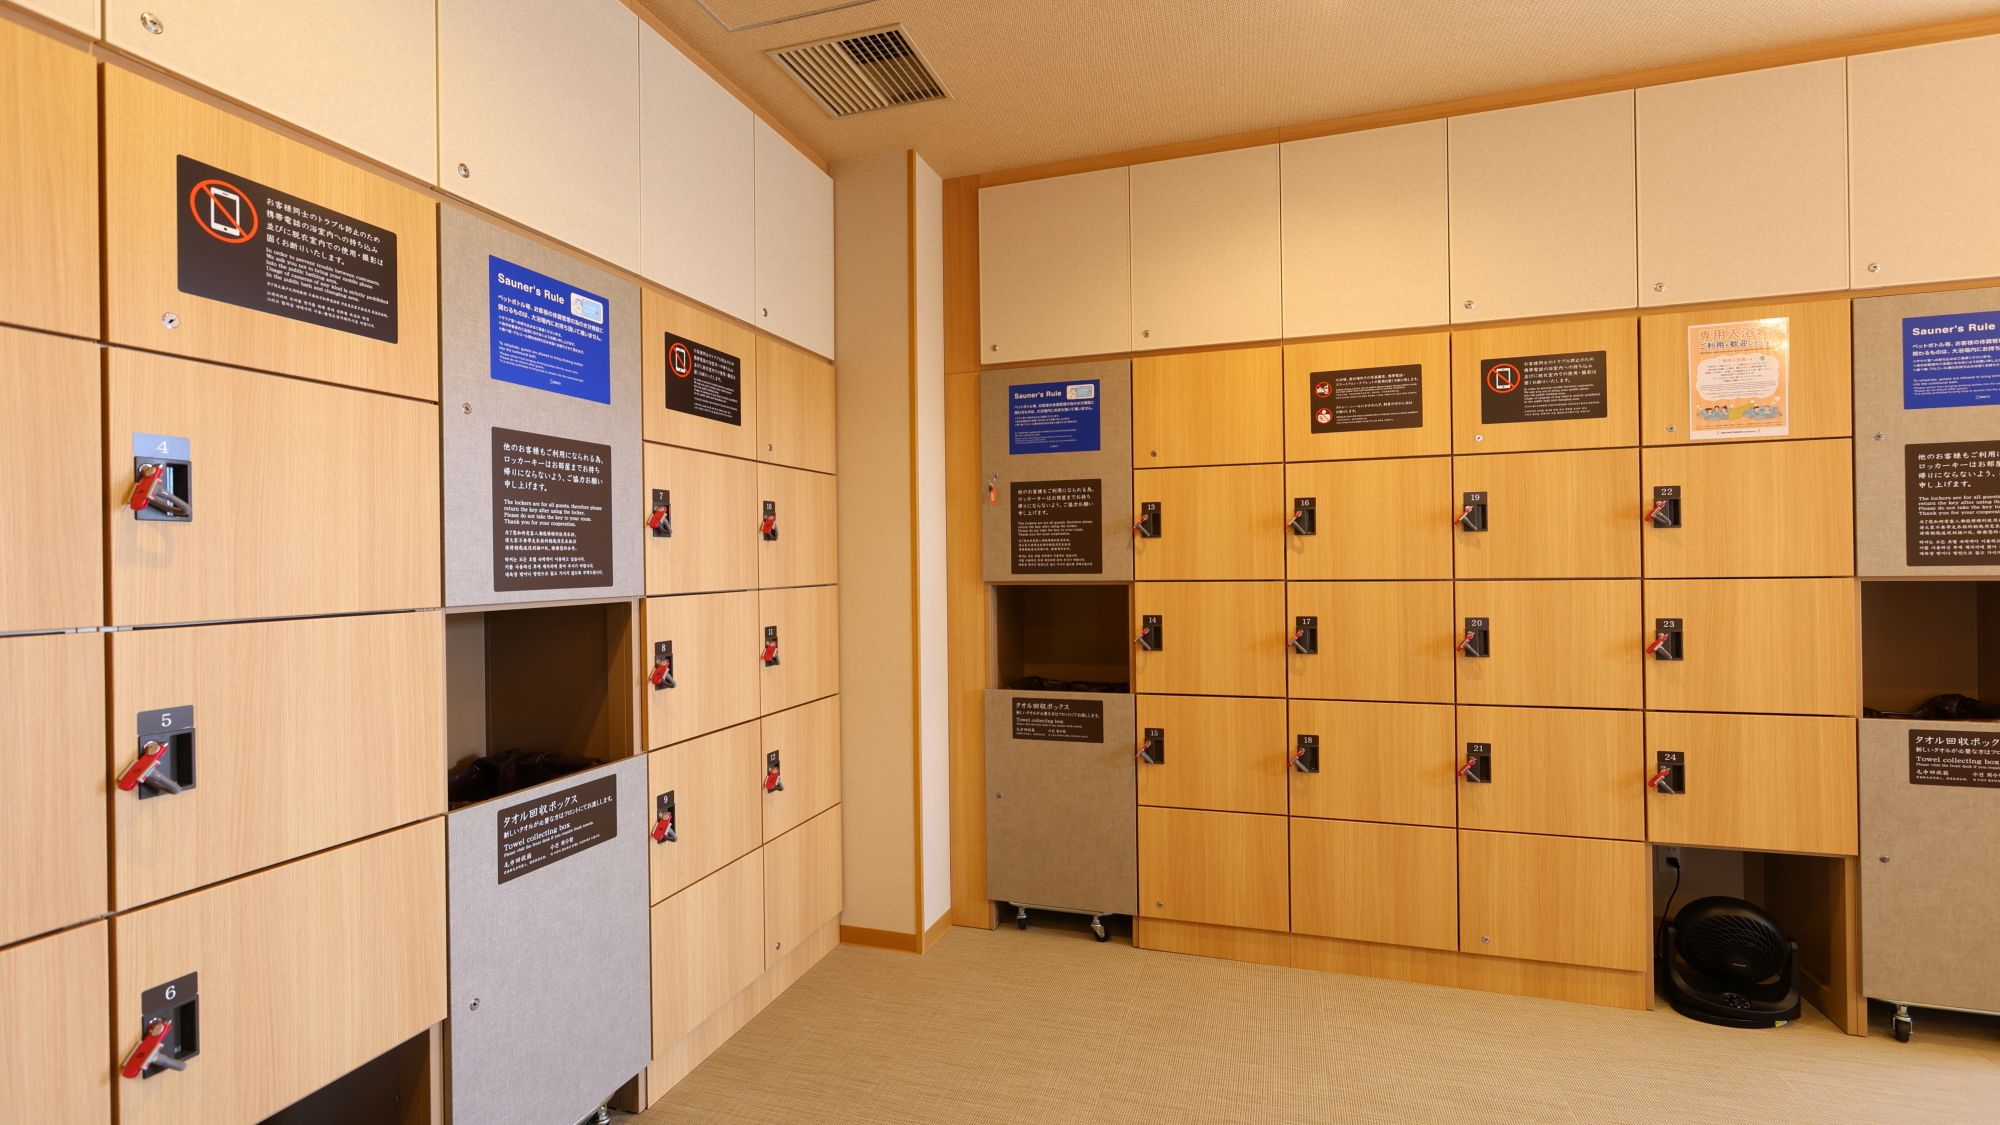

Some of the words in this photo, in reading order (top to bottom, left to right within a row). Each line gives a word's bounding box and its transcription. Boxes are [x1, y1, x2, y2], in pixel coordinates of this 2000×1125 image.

[498, 273, 541, 296] Sauner's
[544, 289, 565, 305] Rule
[1912, 325, 1964, 336] Sauner's
[1968, 322, 1996, 332] Rule
[1912, 338, 2000, 349] ペットボトル等、お客様の体調管
[1014, 392, 1044, 400] Sauner's
[156, 440, 169, 454] 4
[503, 442, 603, 464] 他のお客様もご利用になられる為、
[504, 456, 600, 474] ロッカーキーはお部屋までお持ち
[504, 479, 547, 492] 申し上げます。
[1918, 480, 1971, 489] 申し上げます。
[659, 492, 664, 500] 7
[1661, 488, 1673, 496] 22
[1471, 619, 1482, 627] 20
[1663, 620, 1675, 628] 23
[768, 628, 773, 636] 11
[661, 644, 666, 652] 8
[161, 713, 172, 727] 5
[770, 753, 776, 761] 12
[1664, 753, 1677, 761] 24
[663, 795, 668, 804] 9
[503, 794, 578, 828] タオル回収ボックス
[503, 838, 525, 851] Towel
[526, 827, 558, 843] collecting
[559, 822, 571, 831] box
[165, 985, 176, 1000] 6
